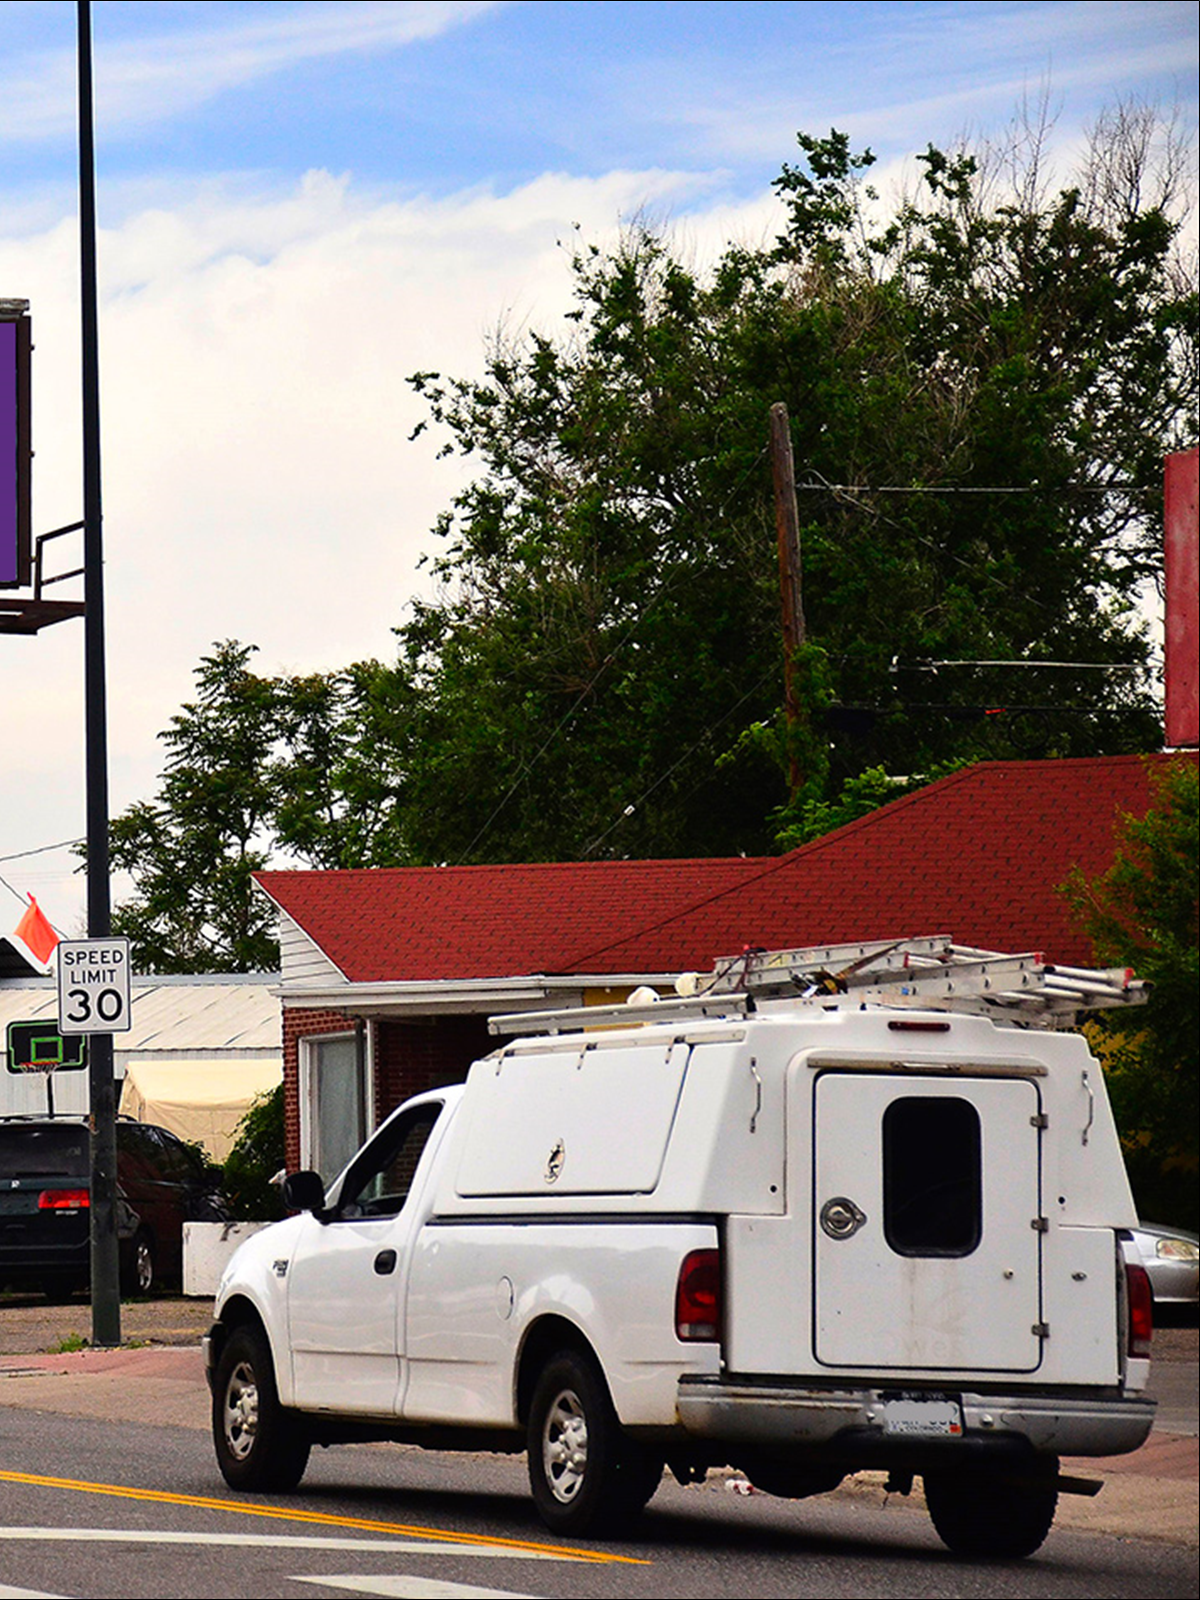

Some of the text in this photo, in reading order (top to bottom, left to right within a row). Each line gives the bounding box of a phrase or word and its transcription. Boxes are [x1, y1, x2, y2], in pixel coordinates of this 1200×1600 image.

[64, 949, 124, 966] SPEED
[71, 969, 117, 984] LIMIT
[67, 988, 123, 1023] 30
